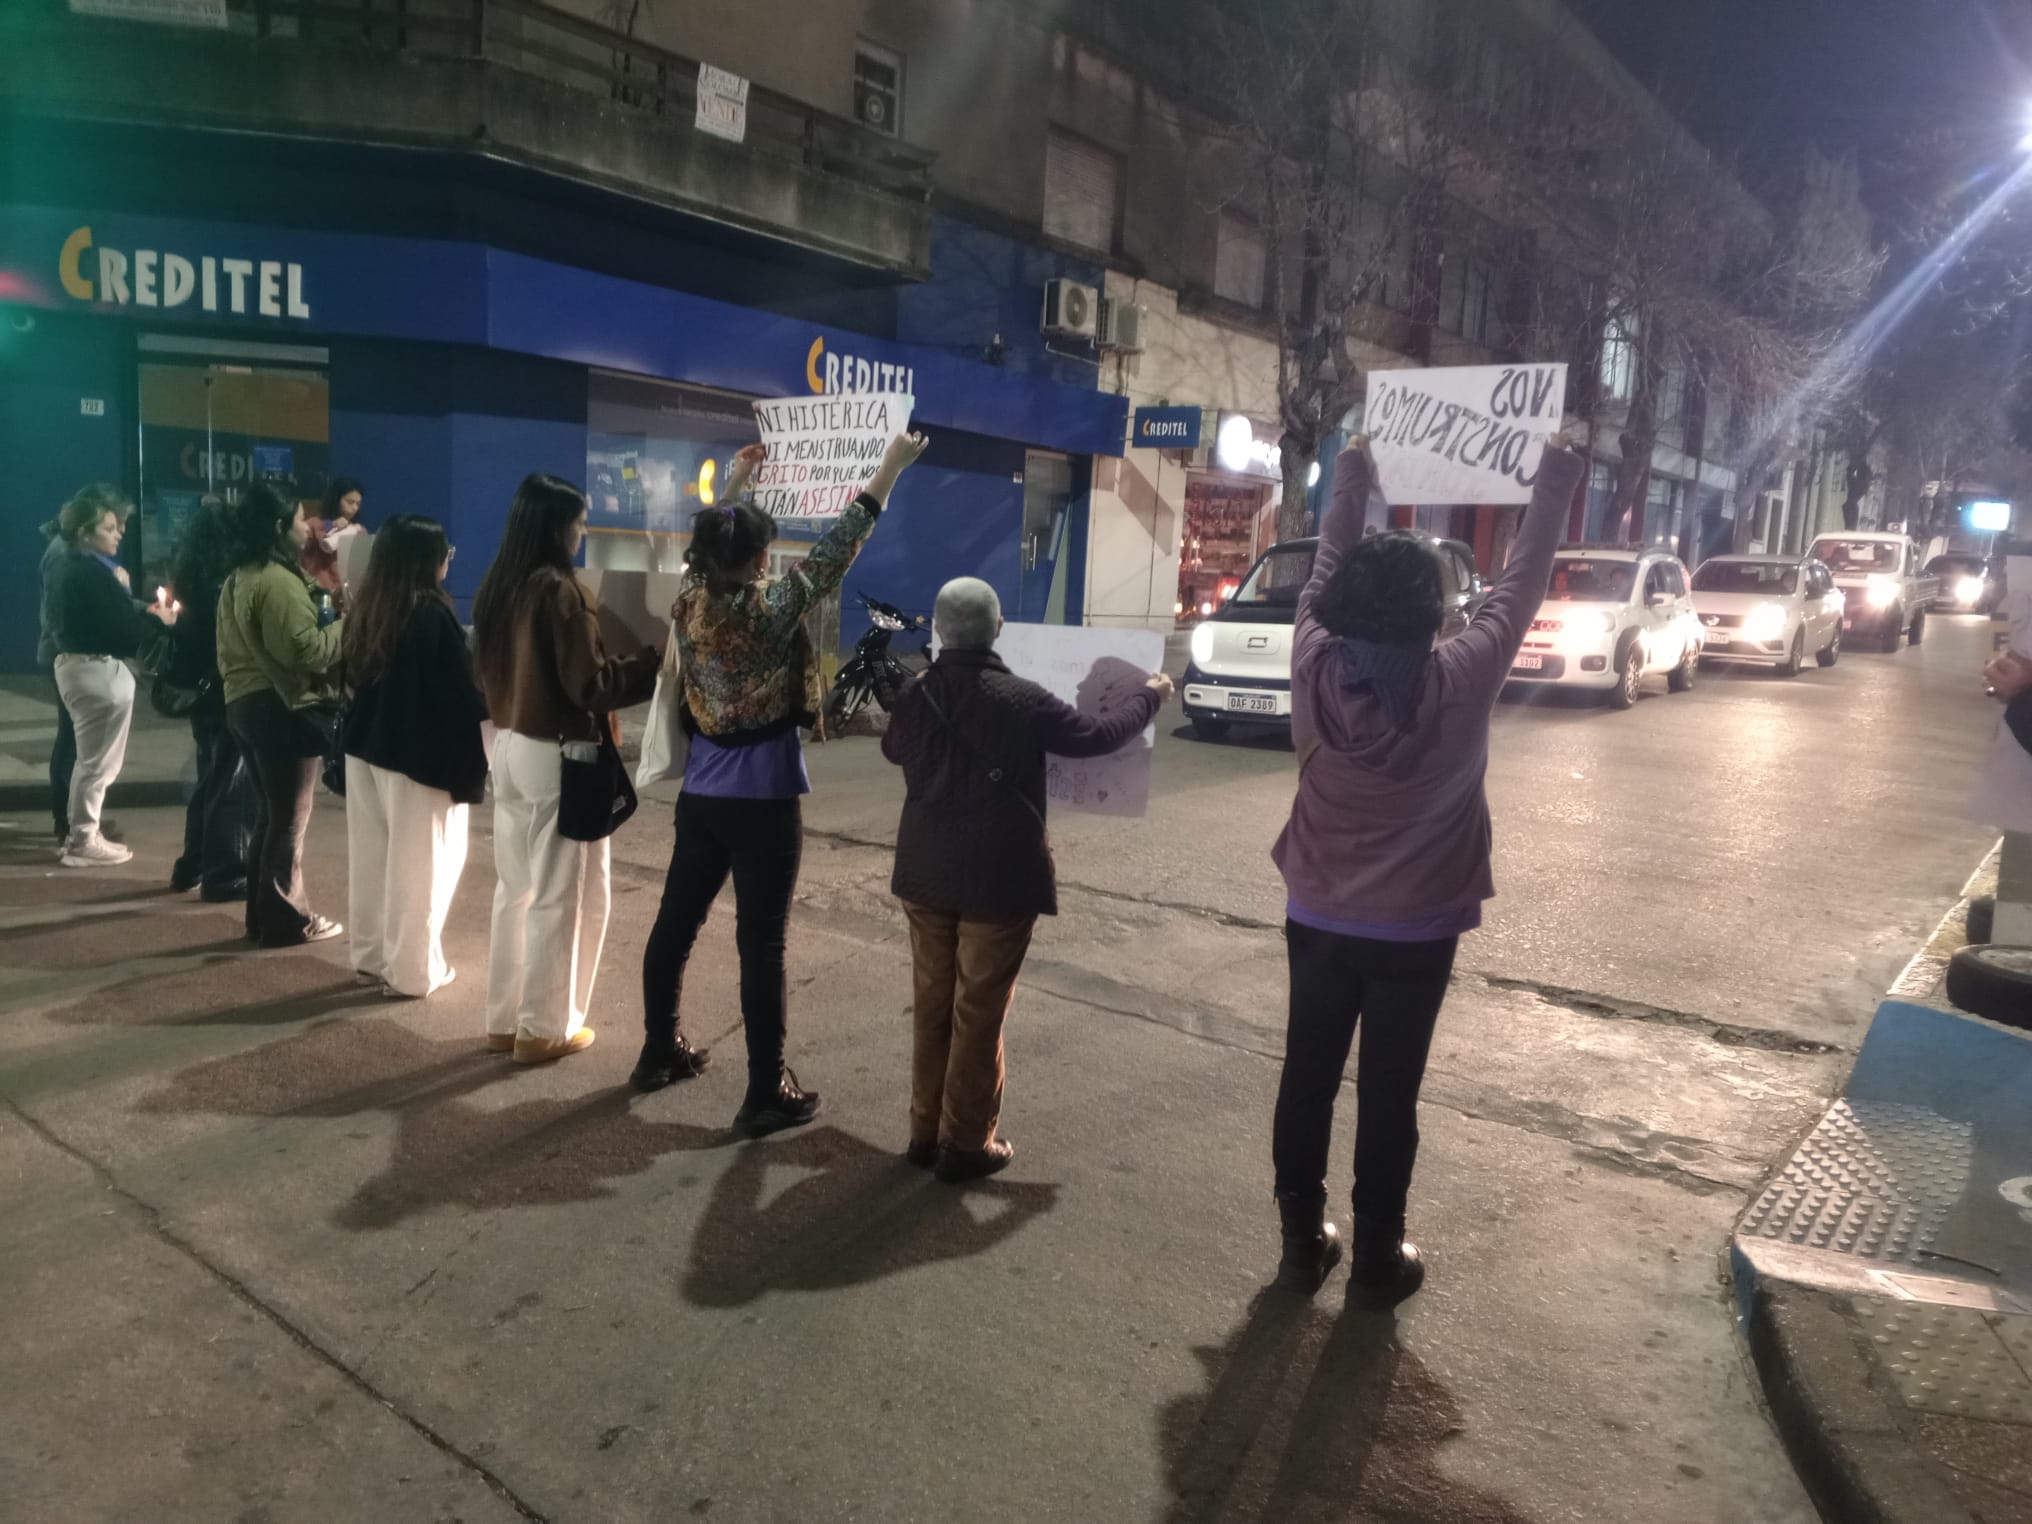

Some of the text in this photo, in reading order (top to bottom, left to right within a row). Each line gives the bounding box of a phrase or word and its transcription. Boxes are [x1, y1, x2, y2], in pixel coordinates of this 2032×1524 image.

[59, 225, 310, 319] CREDITEL
[757, 396, 889, 433] NI HISTÉRICA
[1143, 418, 1187, 436] CREDITEL
[757, 464, 808, 484] GRITO
